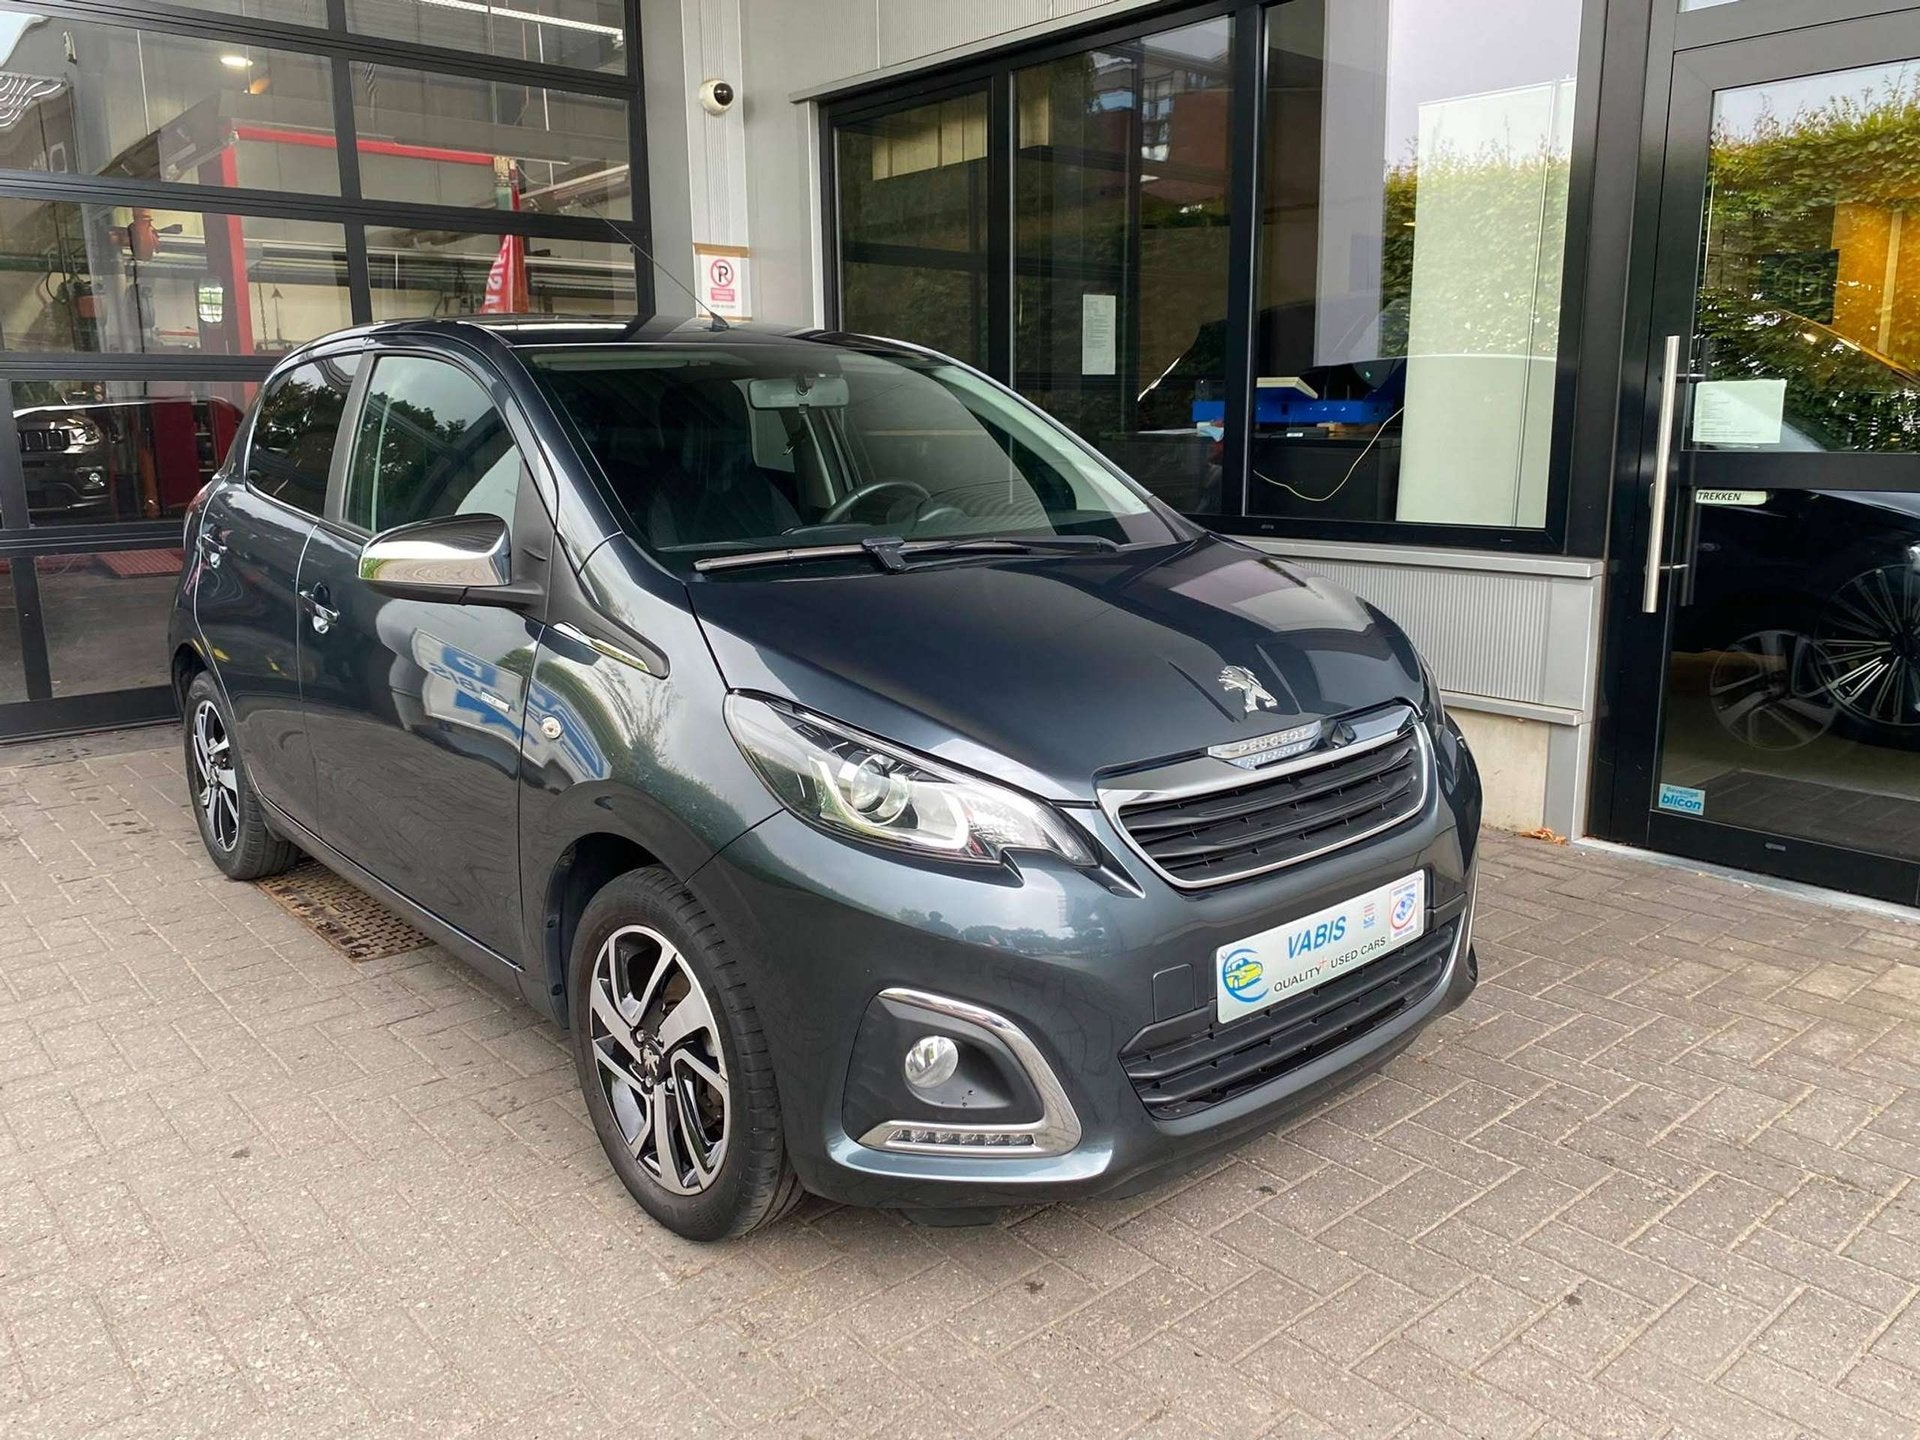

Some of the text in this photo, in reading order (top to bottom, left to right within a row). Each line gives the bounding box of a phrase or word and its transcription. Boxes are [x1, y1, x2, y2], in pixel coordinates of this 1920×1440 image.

[1697, 491, 1742, 501] TREKKEN
[1238, 728, 1308, 755] PEUGEOT
[1661, 793, 1702, 810] blicon
[1288, 915, 1347, 959] VABIS
[1329, 949, 1359, 969] USED
[1360, 936, 1387, 956] CARS
